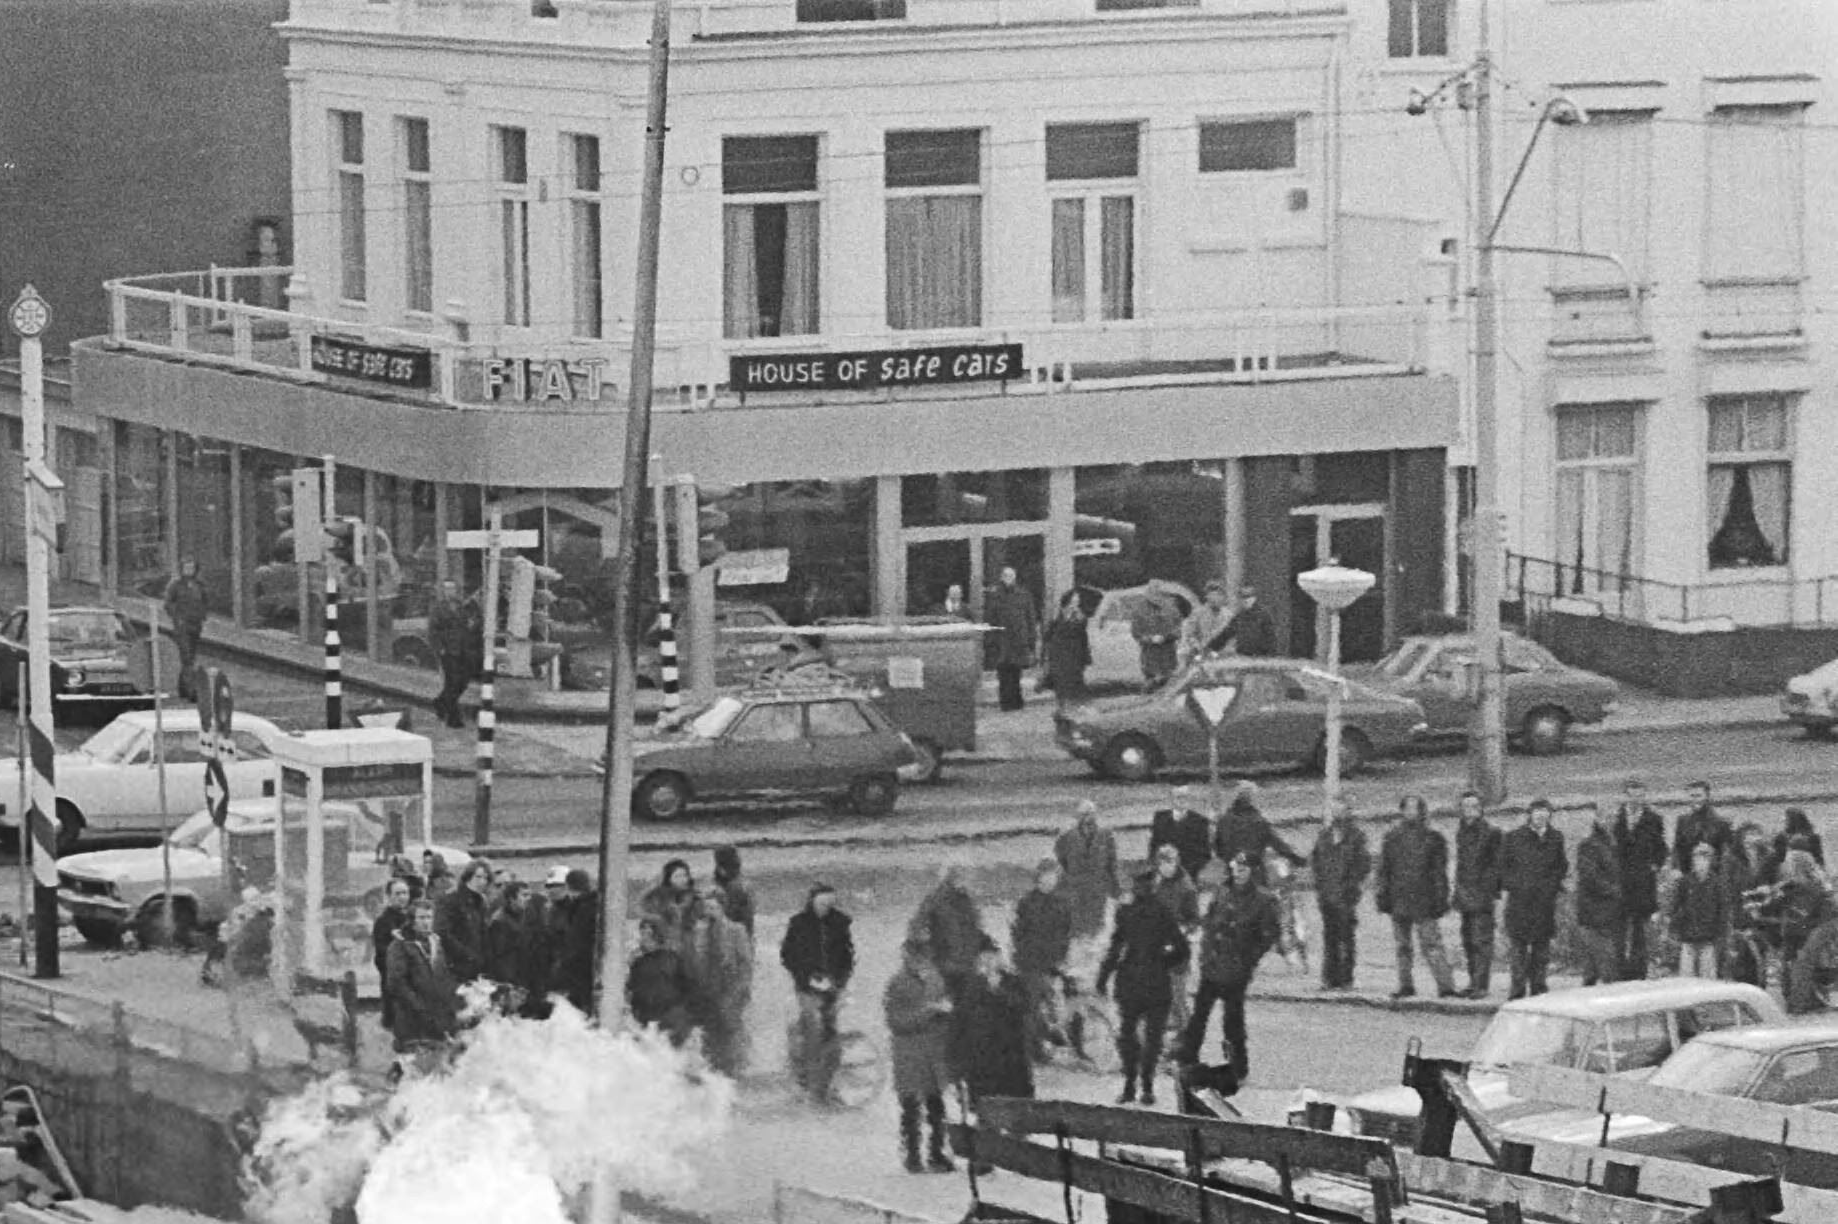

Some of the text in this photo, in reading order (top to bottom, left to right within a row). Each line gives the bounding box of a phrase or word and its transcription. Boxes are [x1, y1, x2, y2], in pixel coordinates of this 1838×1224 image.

[482, 359, 609, 401] FIAT
[748, 352, 1009, 383] HOUSE OF safe cars
